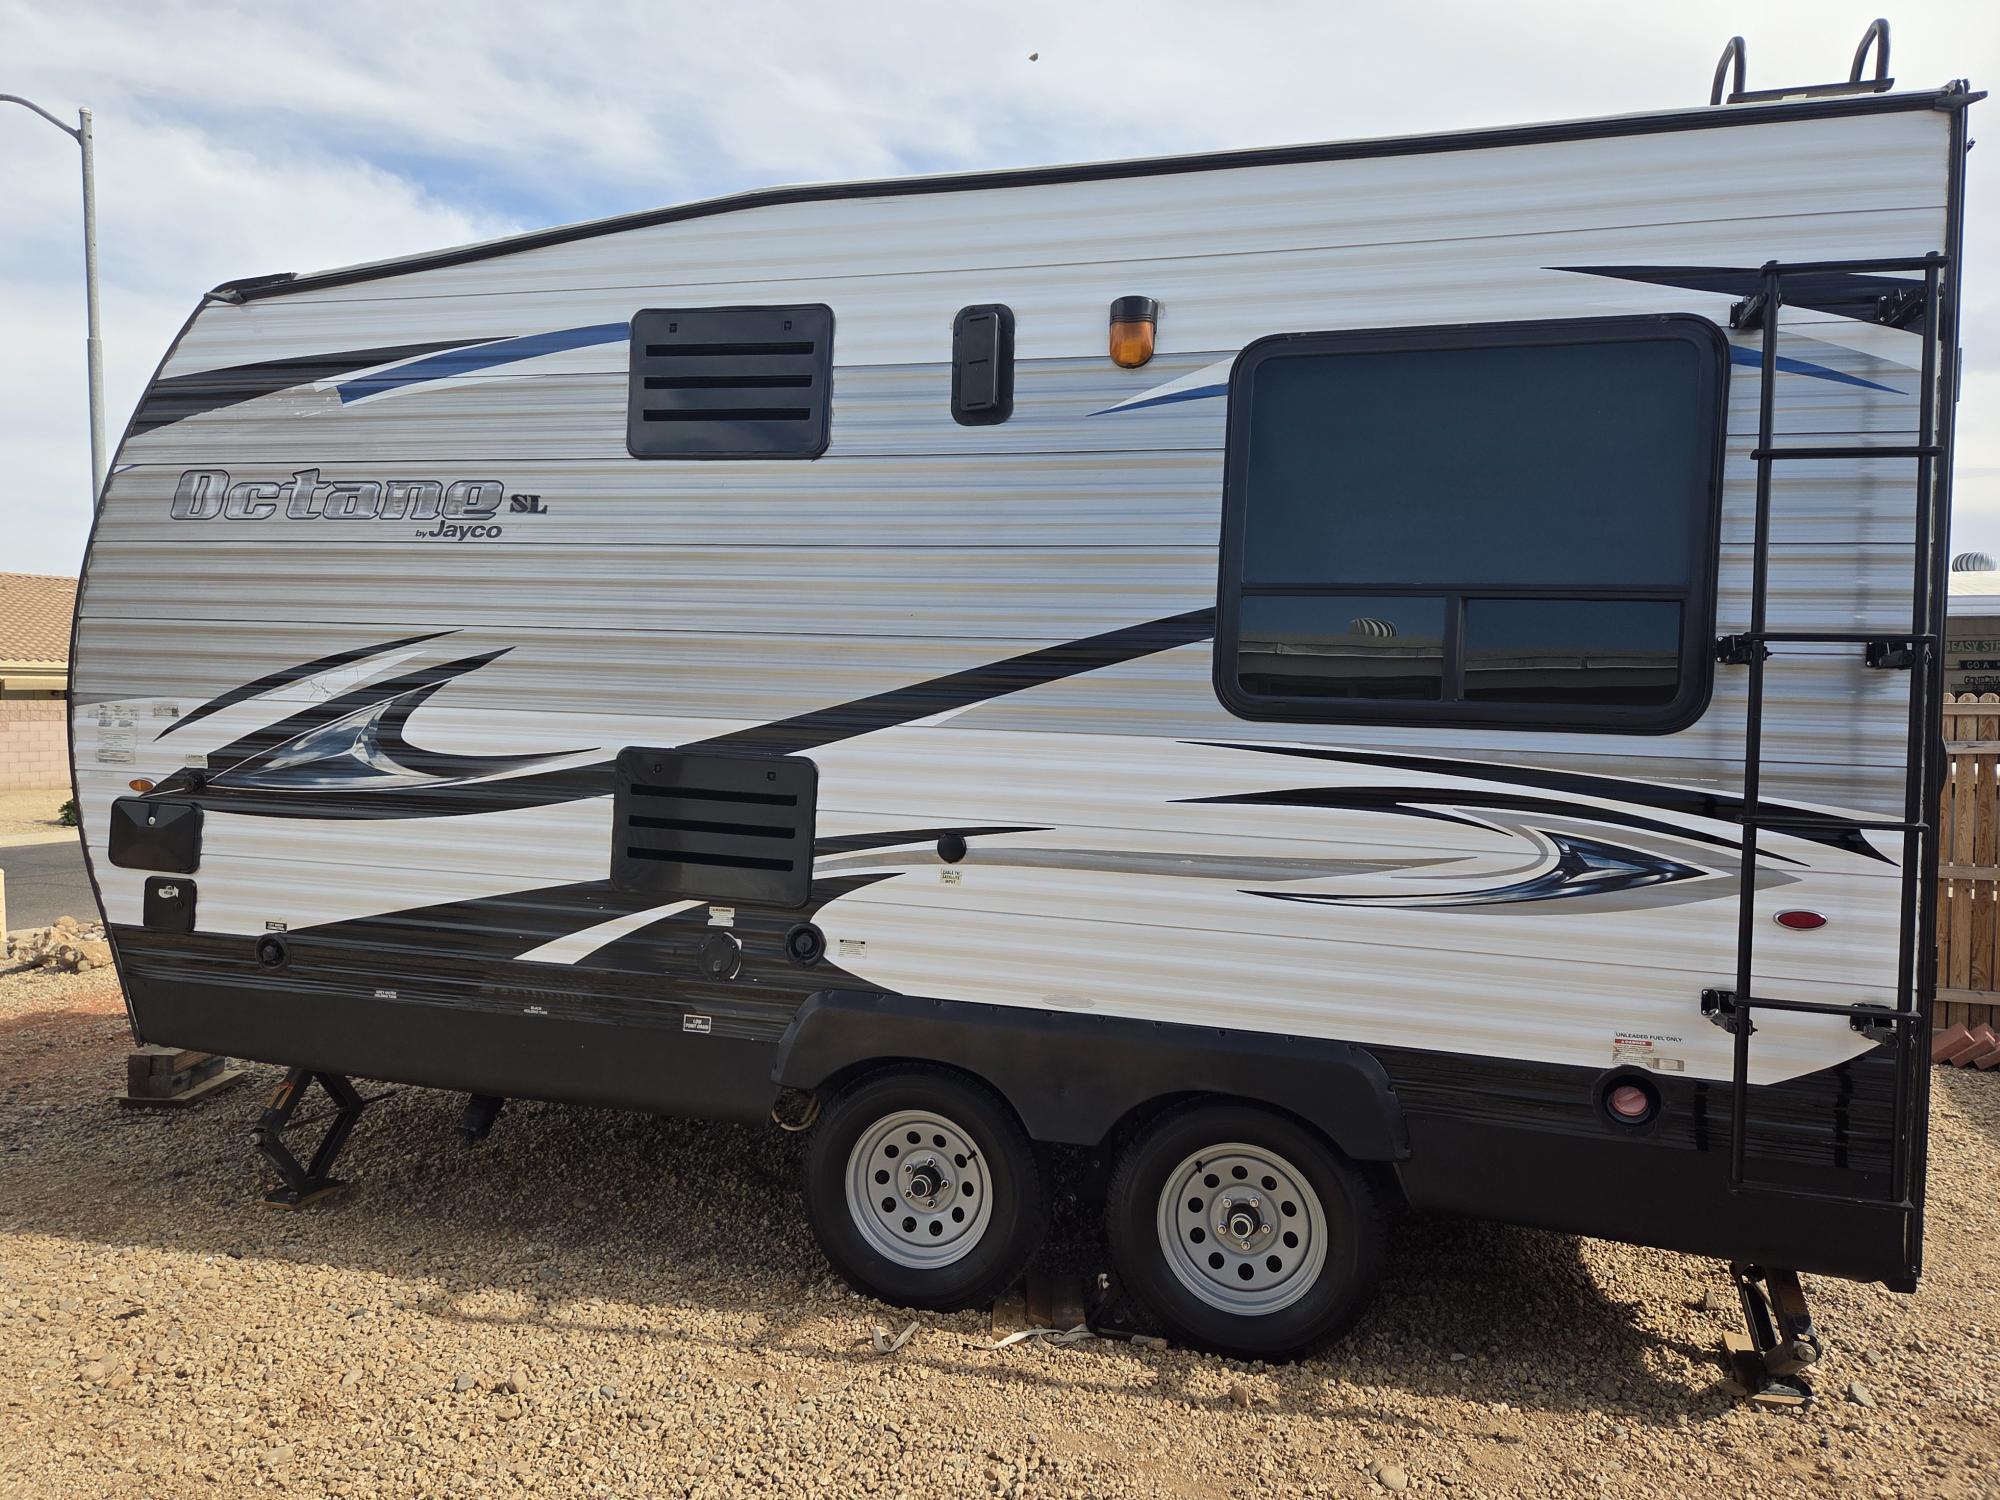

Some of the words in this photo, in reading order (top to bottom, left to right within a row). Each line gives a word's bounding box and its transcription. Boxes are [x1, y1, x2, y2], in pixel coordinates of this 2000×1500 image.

[170, 468, 505, 521] Octane
[509, 494, 548, 515] SL
[415, 529, 428, 538] by
[429, 520, 503, 541] Jayco
[1951, 641, 1977, 652] EASY
